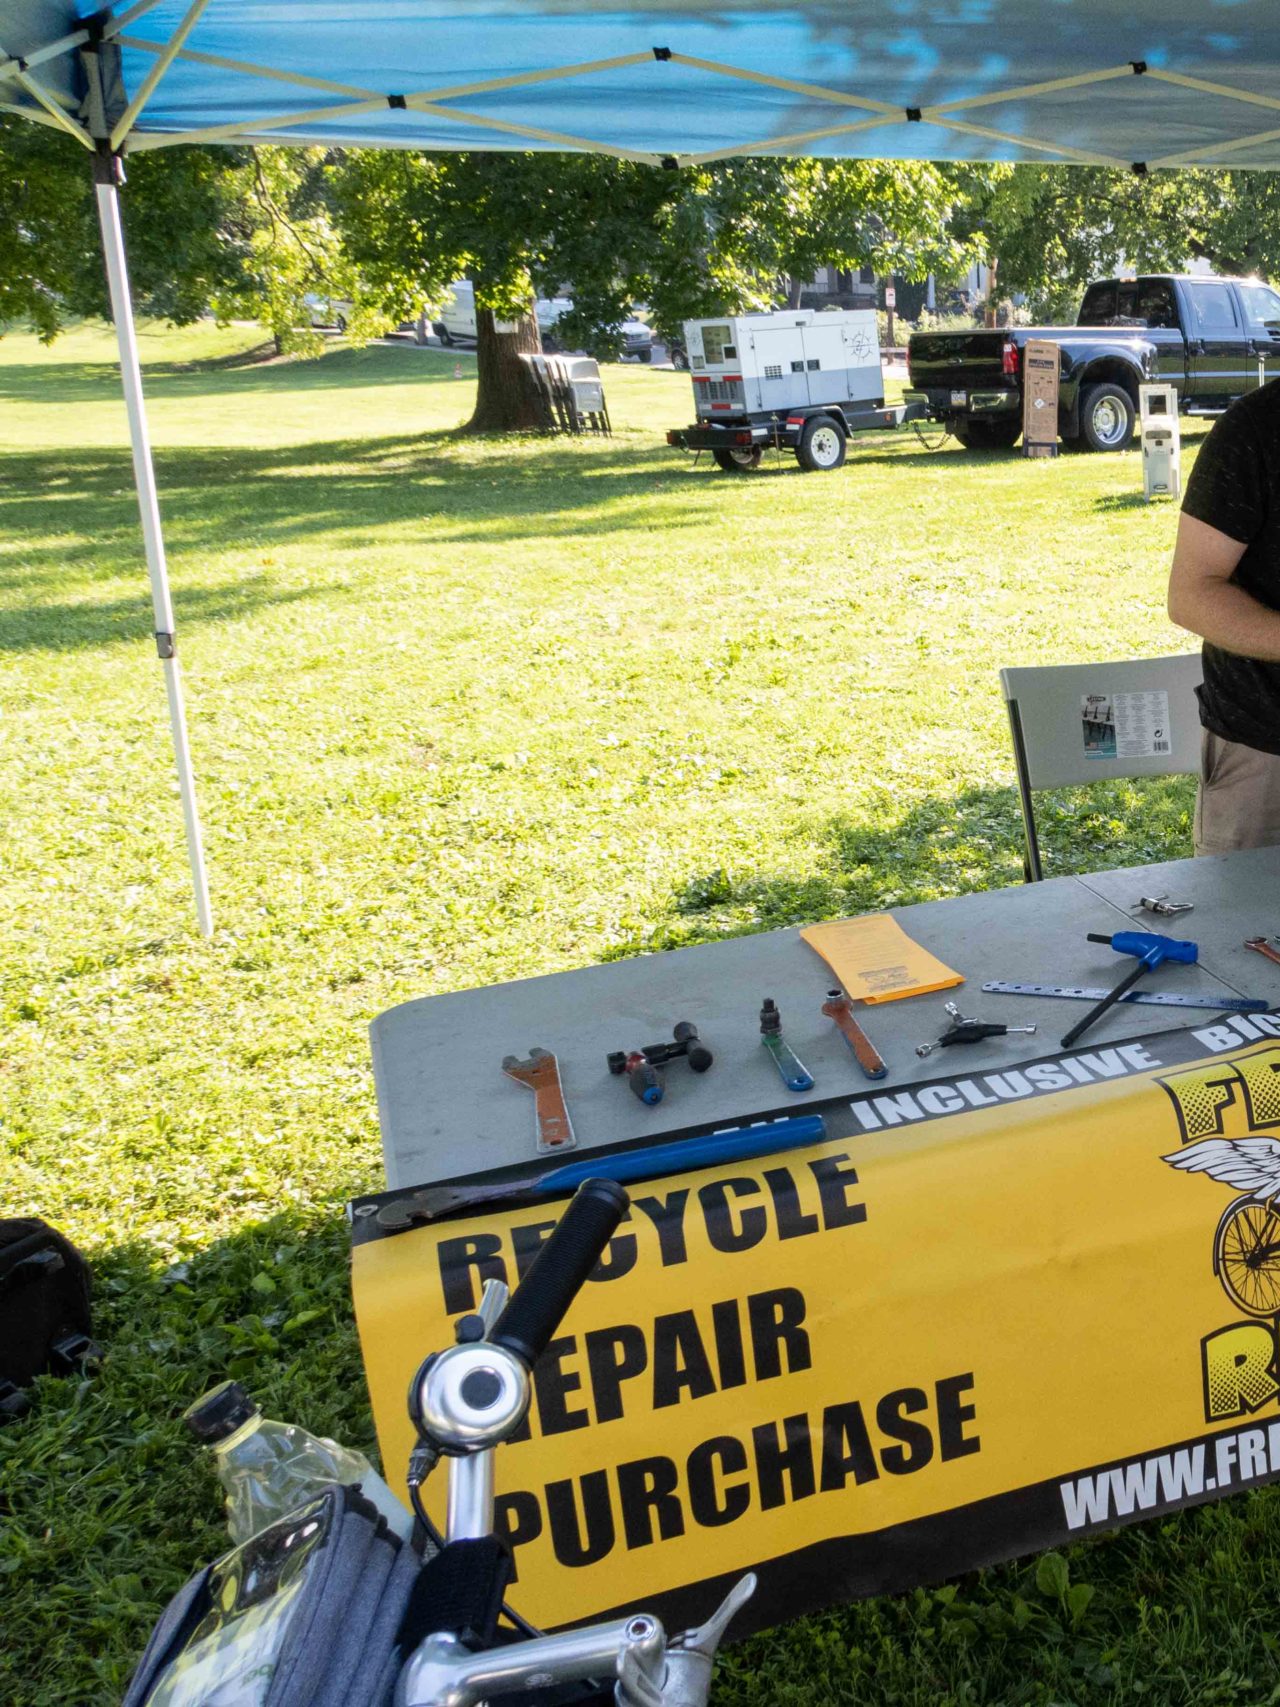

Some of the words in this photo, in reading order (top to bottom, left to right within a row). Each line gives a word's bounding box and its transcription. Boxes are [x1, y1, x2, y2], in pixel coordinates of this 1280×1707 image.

[850, 1042, 1162, 1133] INCLUSIVE
[496, 1286, 813, 1446] EPAIR
[494, 1372, 982, 1586] PURCHASE
